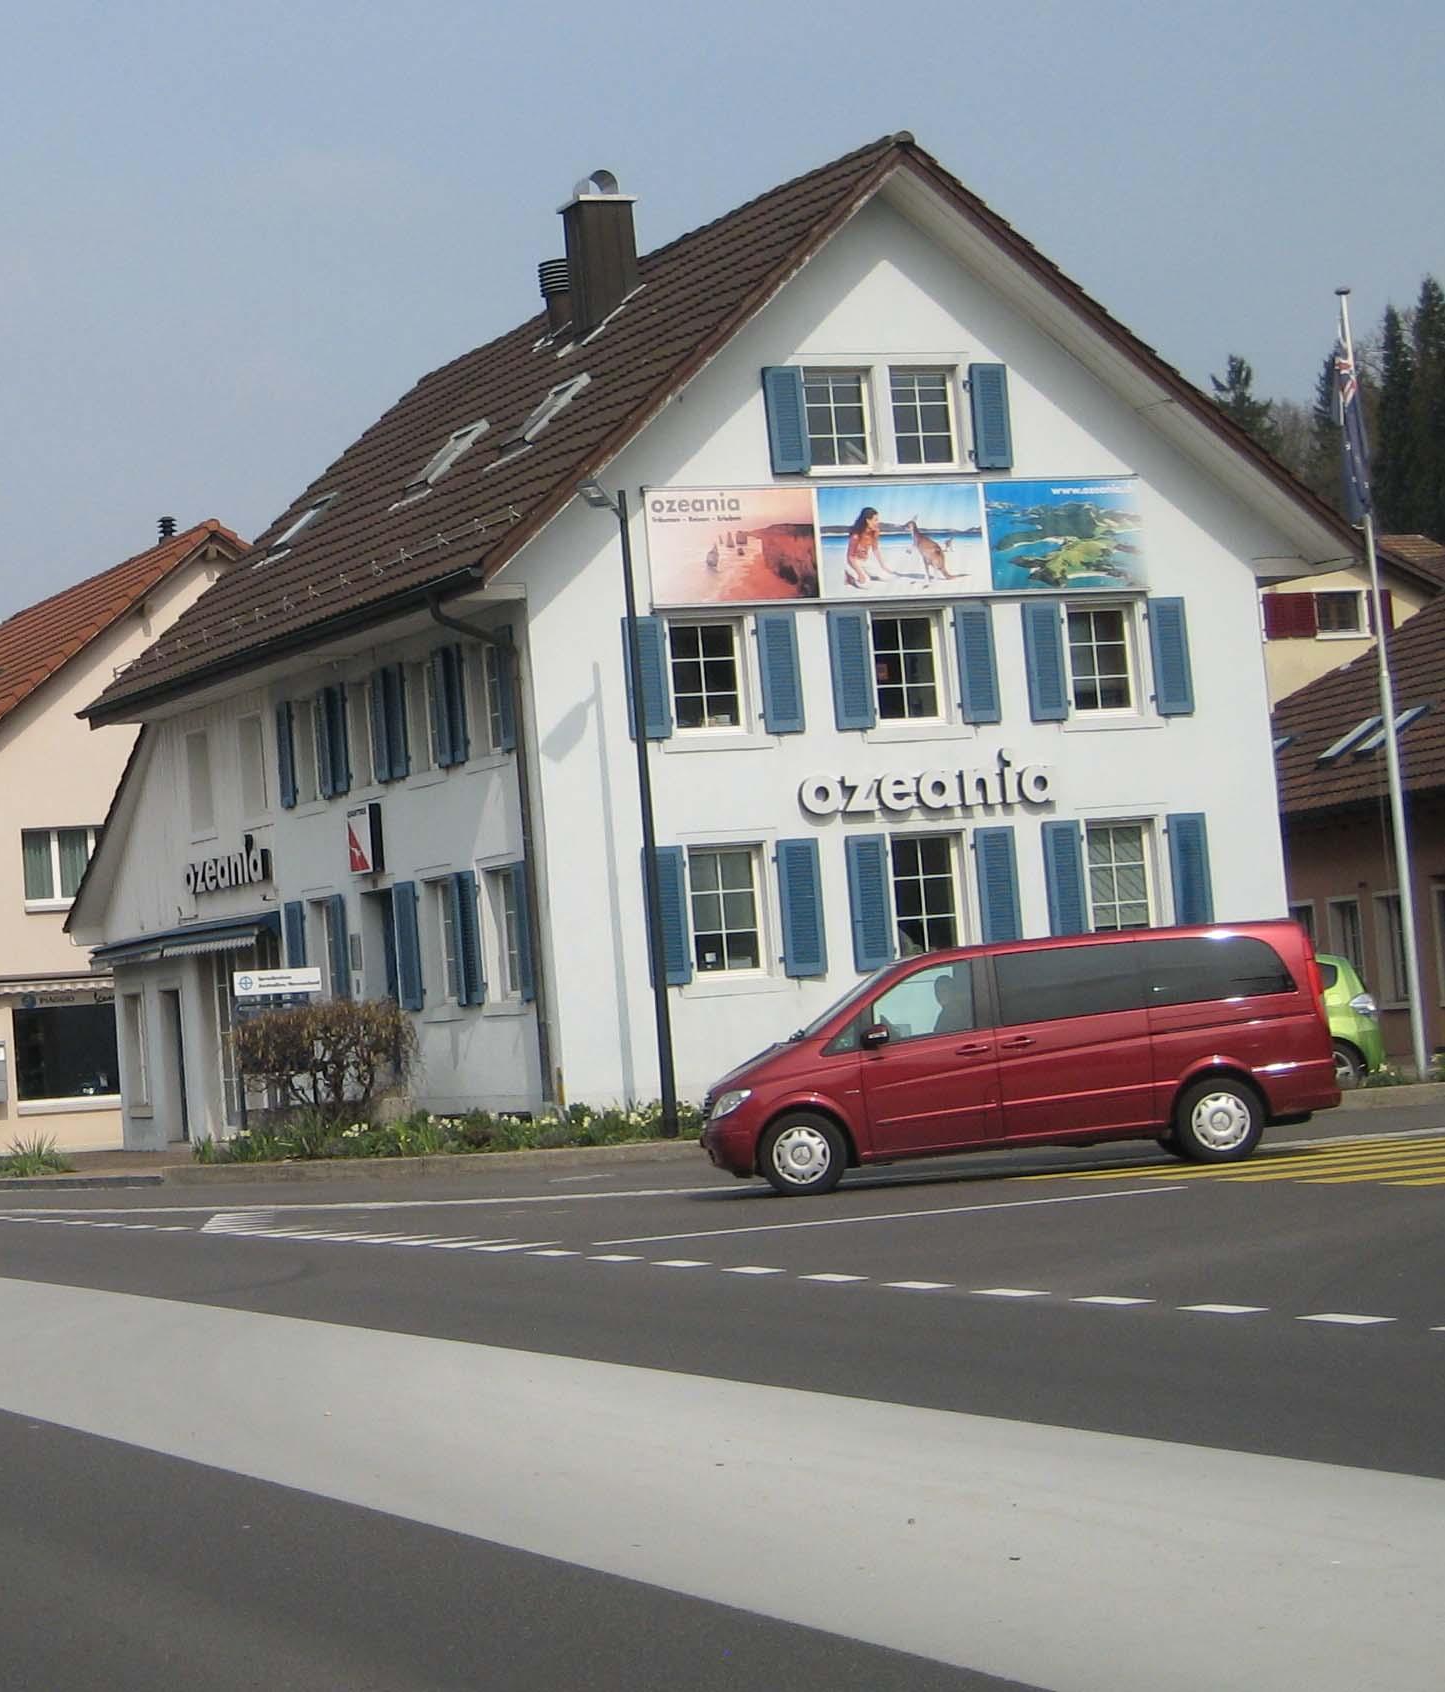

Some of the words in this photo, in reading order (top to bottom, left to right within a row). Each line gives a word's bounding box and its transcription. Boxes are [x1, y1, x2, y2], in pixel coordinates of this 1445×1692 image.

[651, 492, 741, 513] ozeania
[798, 747, 1056, 816] ozeania
[185, 834, 266, 895] ozeania
